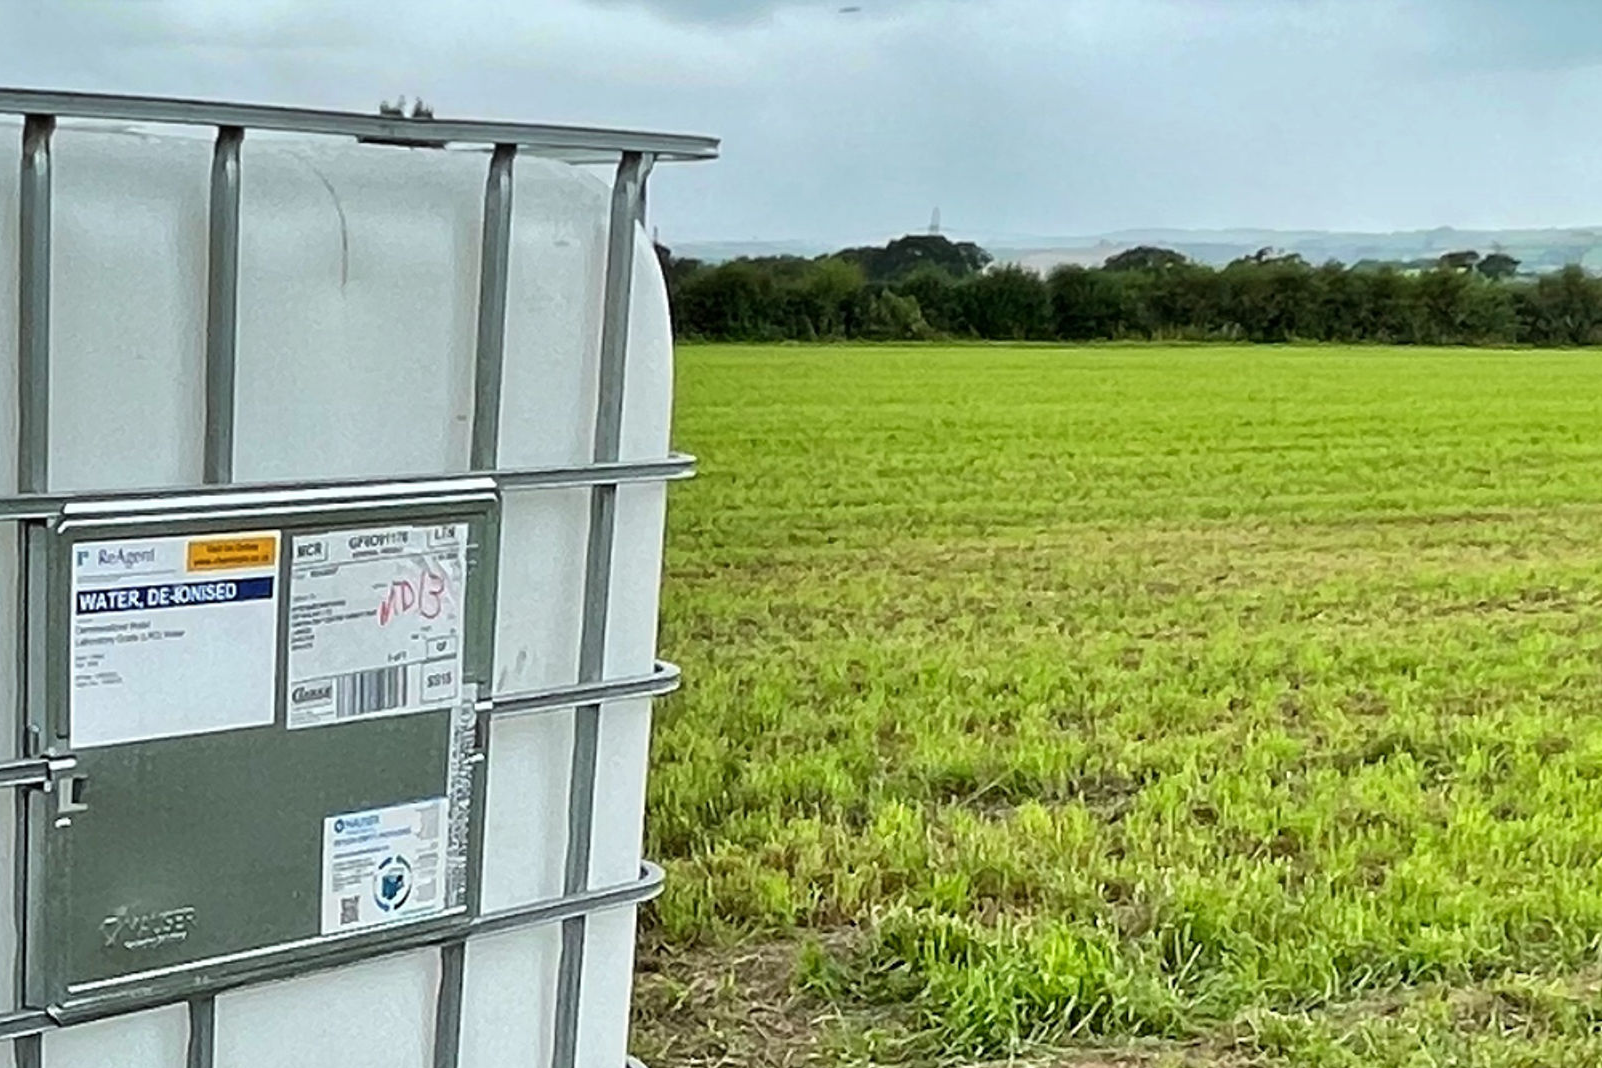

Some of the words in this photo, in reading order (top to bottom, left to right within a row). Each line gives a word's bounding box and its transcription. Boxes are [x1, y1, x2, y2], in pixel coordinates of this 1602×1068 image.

[98, 547, 155, 569] ReAgent
[79, 590, 144, 611] WATER,
[148, 582, 237, 607] DE-IONISED
